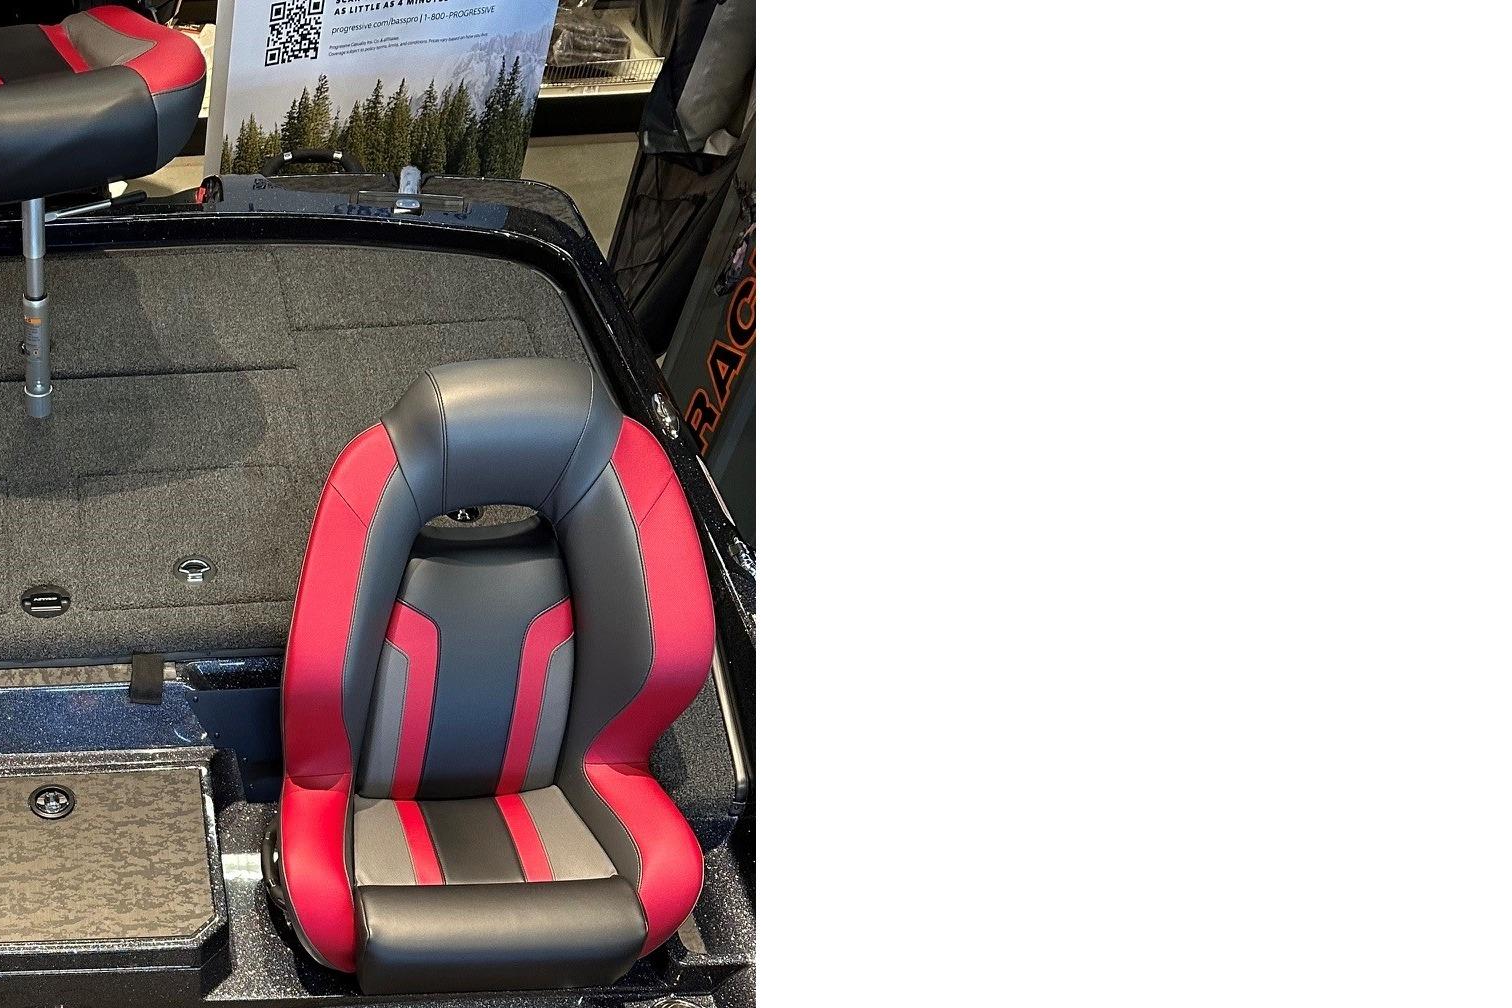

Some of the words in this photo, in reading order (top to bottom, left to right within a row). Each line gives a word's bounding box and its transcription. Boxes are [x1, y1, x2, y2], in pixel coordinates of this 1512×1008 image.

[331, 16, 418, 35] progressive.com/basspro
[424, 5, 496, 21] 1-800-PROGRESSIVE
[334, 7, 346, 15] AS
[349, 3, 381, 14] LITTLE
[383, 0, 395, 9] AS
[685, 246, 756, 454] RAC
